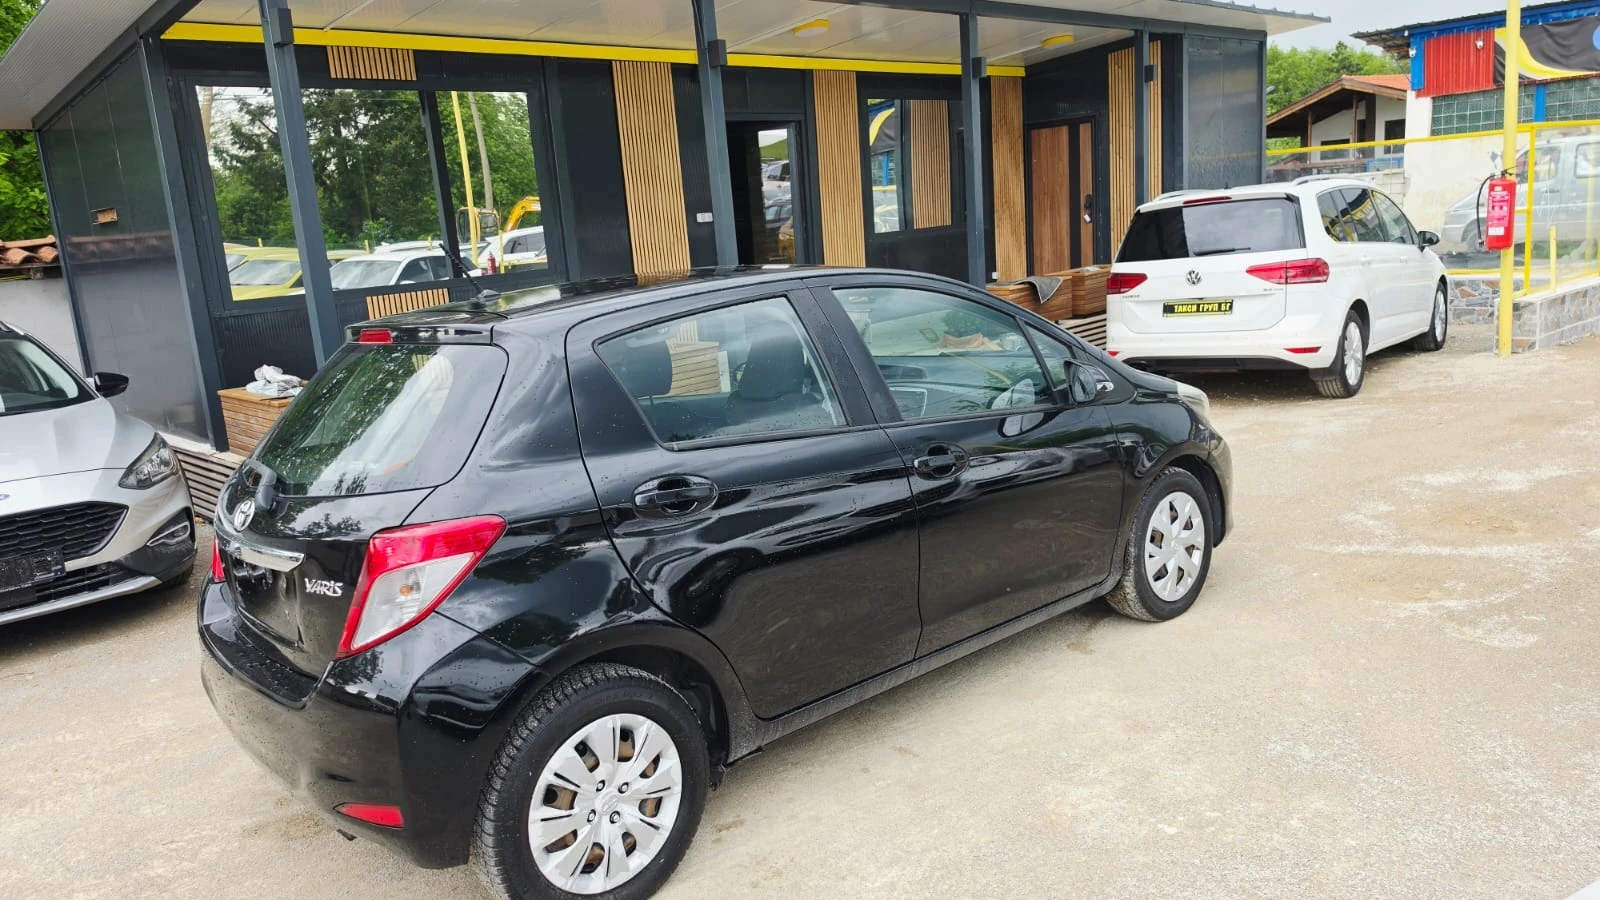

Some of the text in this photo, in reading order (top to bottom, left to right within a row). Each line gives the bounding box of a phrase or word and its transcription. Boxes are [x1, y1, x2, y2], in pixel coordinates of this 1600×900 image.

[1174, 302, 1231, 313] ТАКСИ ГРУП БГ
